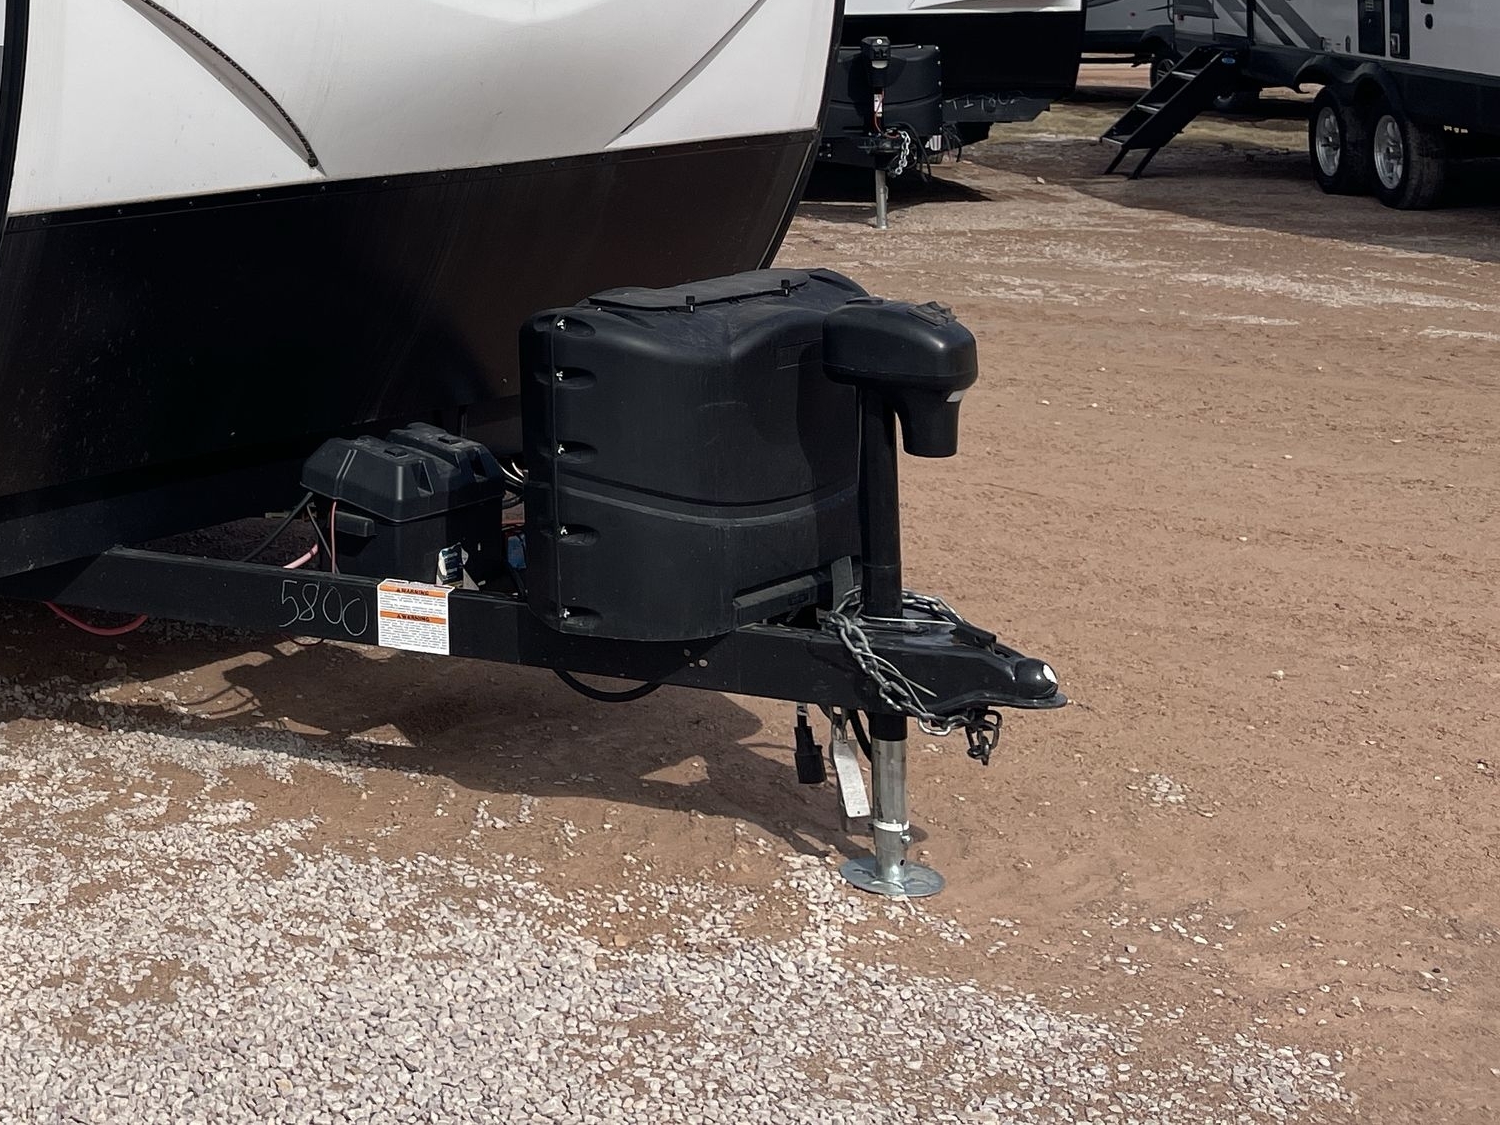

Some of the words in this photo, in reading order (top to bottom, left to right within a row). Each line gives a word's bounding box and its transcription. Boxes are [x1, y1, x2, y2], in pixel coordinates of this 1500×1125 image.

[401, 587, 430, 596] WARNING
[279, 579, 368, 637] 5800
[401, 614, 430, 622] WARNING
